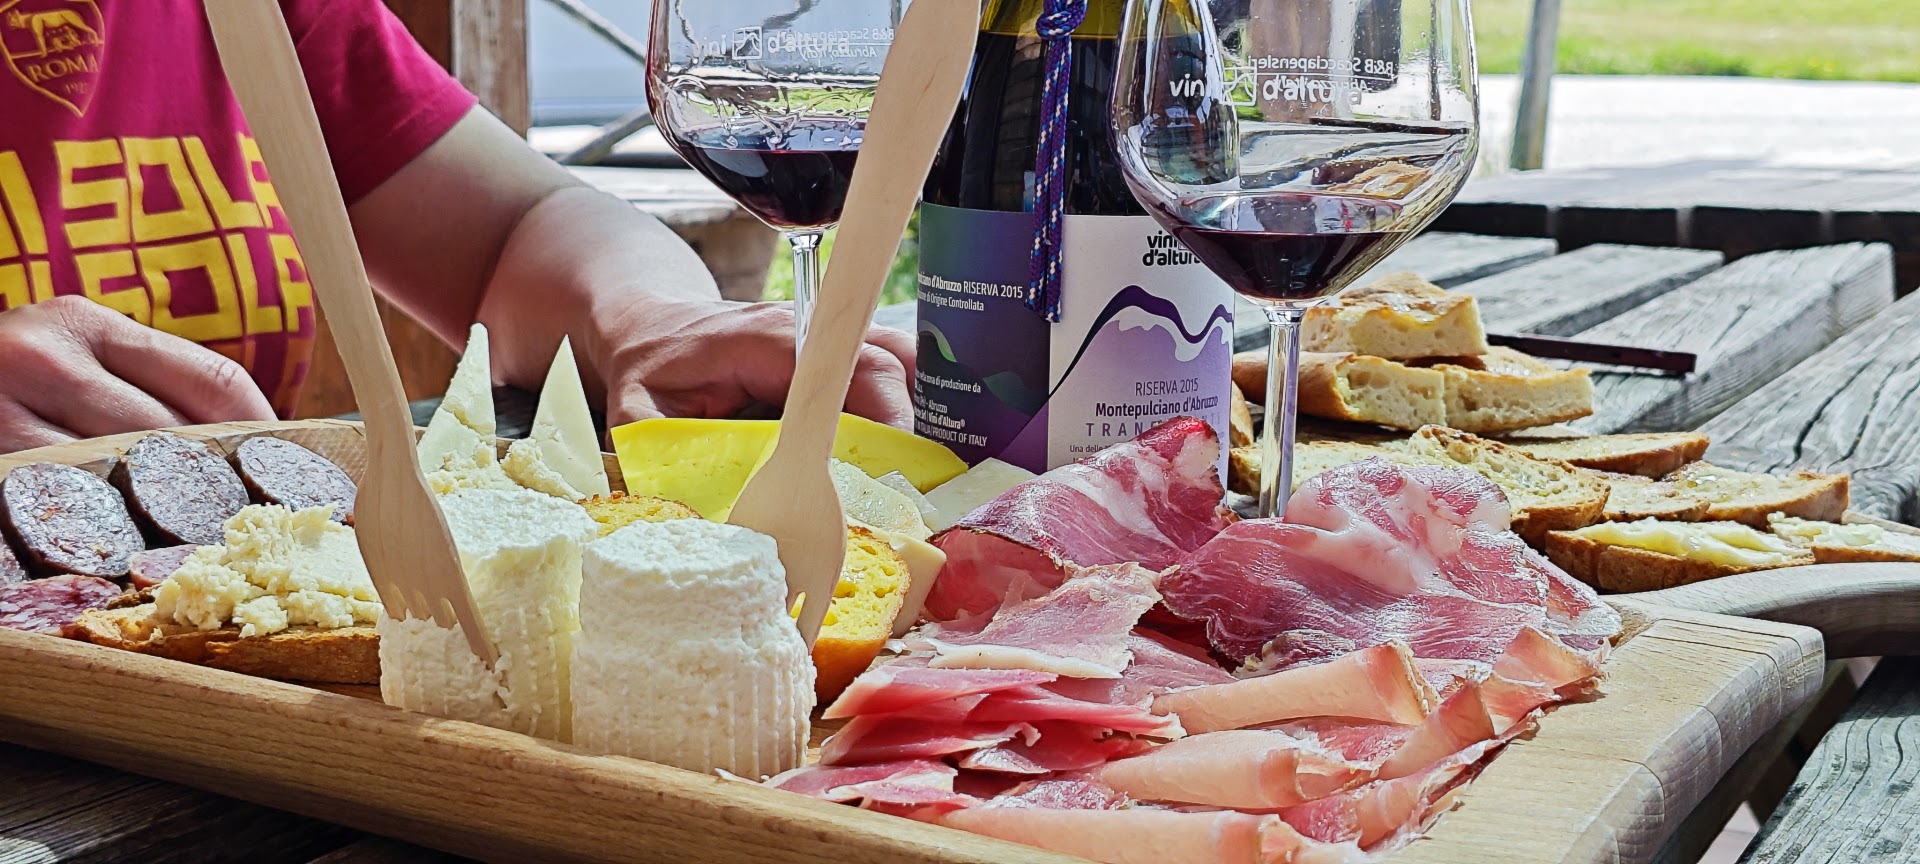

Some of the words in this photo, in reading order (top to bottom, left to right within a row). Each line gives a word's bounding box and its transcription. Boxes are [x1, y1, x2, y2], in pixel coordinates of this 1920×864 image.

[27, 53, 99, 83] ROMA
[931, 274, 962, 293] d'Abruzzo
[963, 280, 999, 297] RISERVA
[1000, 284, 1023, 299] 2015
[931, 293, 948, 307] Origine
[948, 296, 985, 311] Controllata
[940, 378, 972, 392] produzione
[972, 382, 982, 393] da
[1135, 380, 1178, 397] RISERVA
[1180, 377, 1199, 393] 2015
[1095, 399, 1181, 420] Montepulciano
[1182, 395, 1219, 413] d'Abruzzo
[958, 432, 968, 444] OF
[968, 434, 988, 447] ITALY
[1069, 444, 1084, 453] Una
